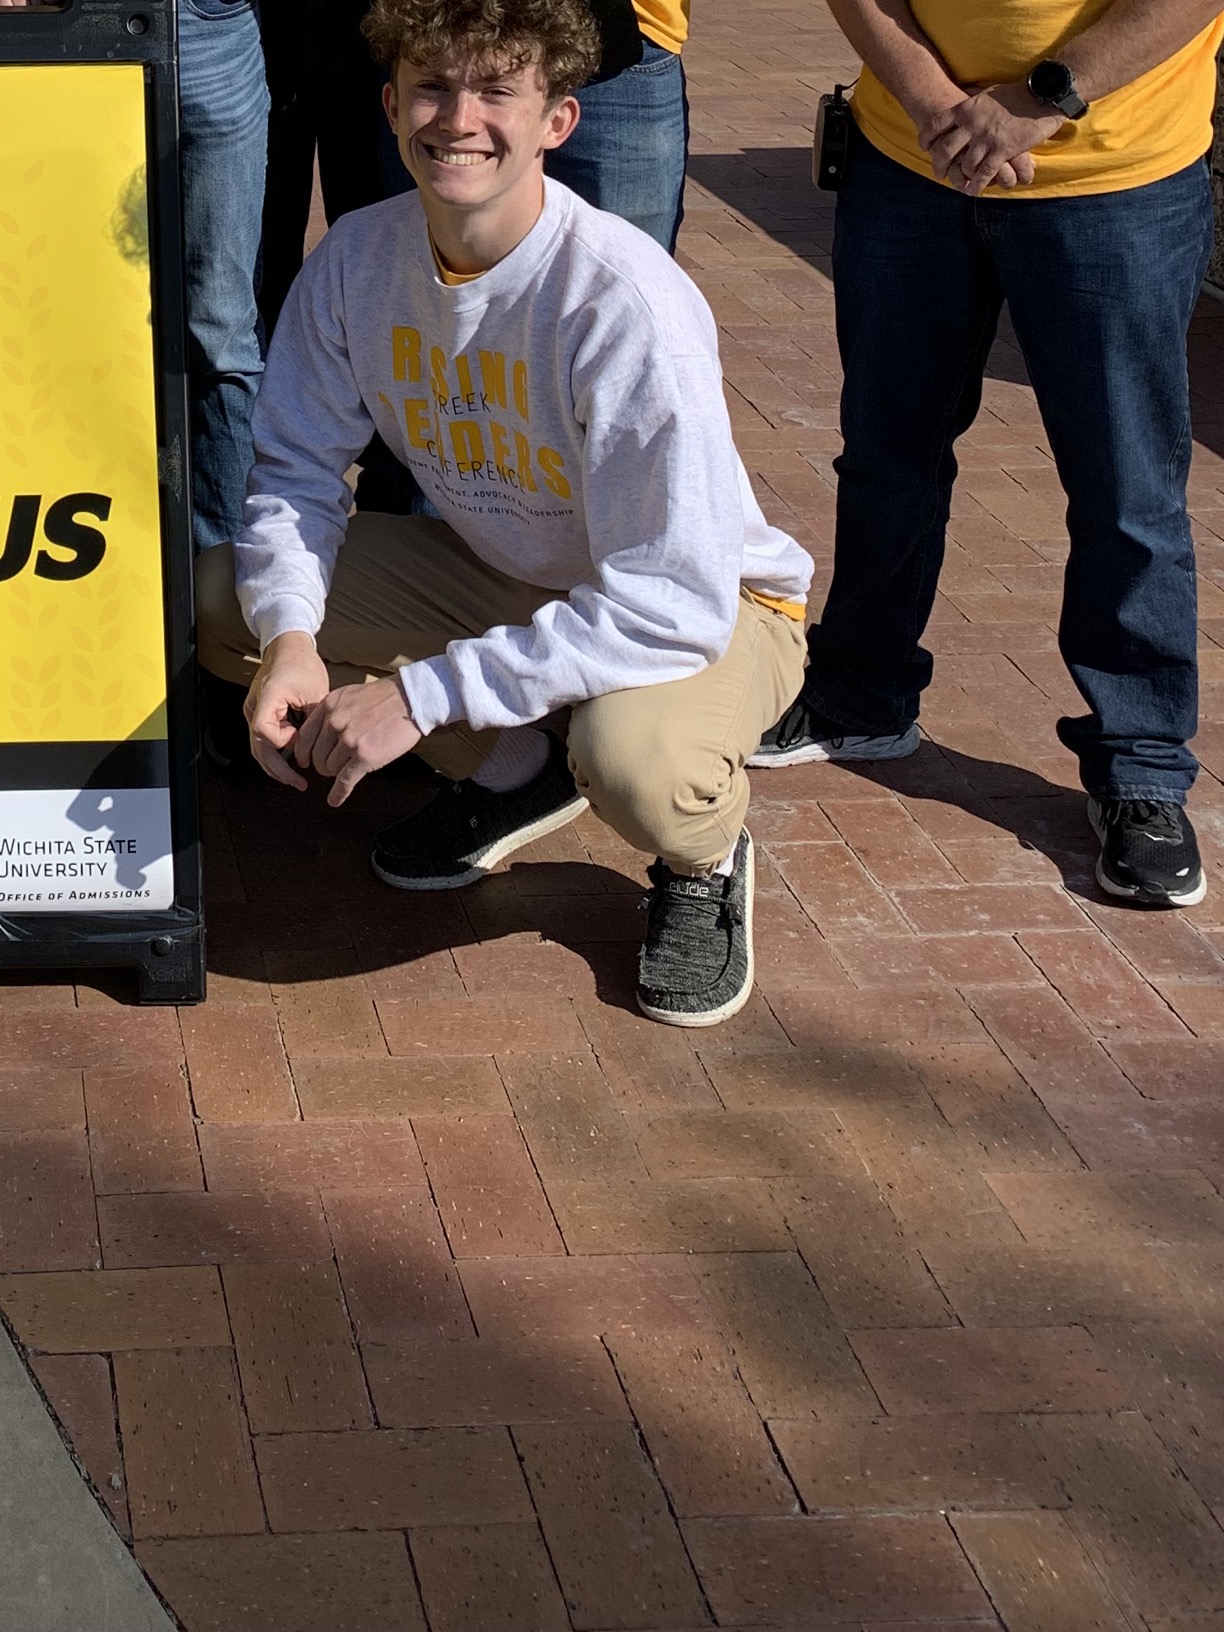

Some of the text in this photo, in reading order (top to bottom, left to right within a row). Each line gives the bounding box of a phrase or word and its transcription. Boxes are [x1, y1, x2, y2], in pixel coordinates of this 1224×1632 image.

[392, 325, 531, 423] RSING
[83, 836, 137, 854] STATE
[47, 891, 63, 901] OF
[68, 889, 151, 901] ADMISSIONS
